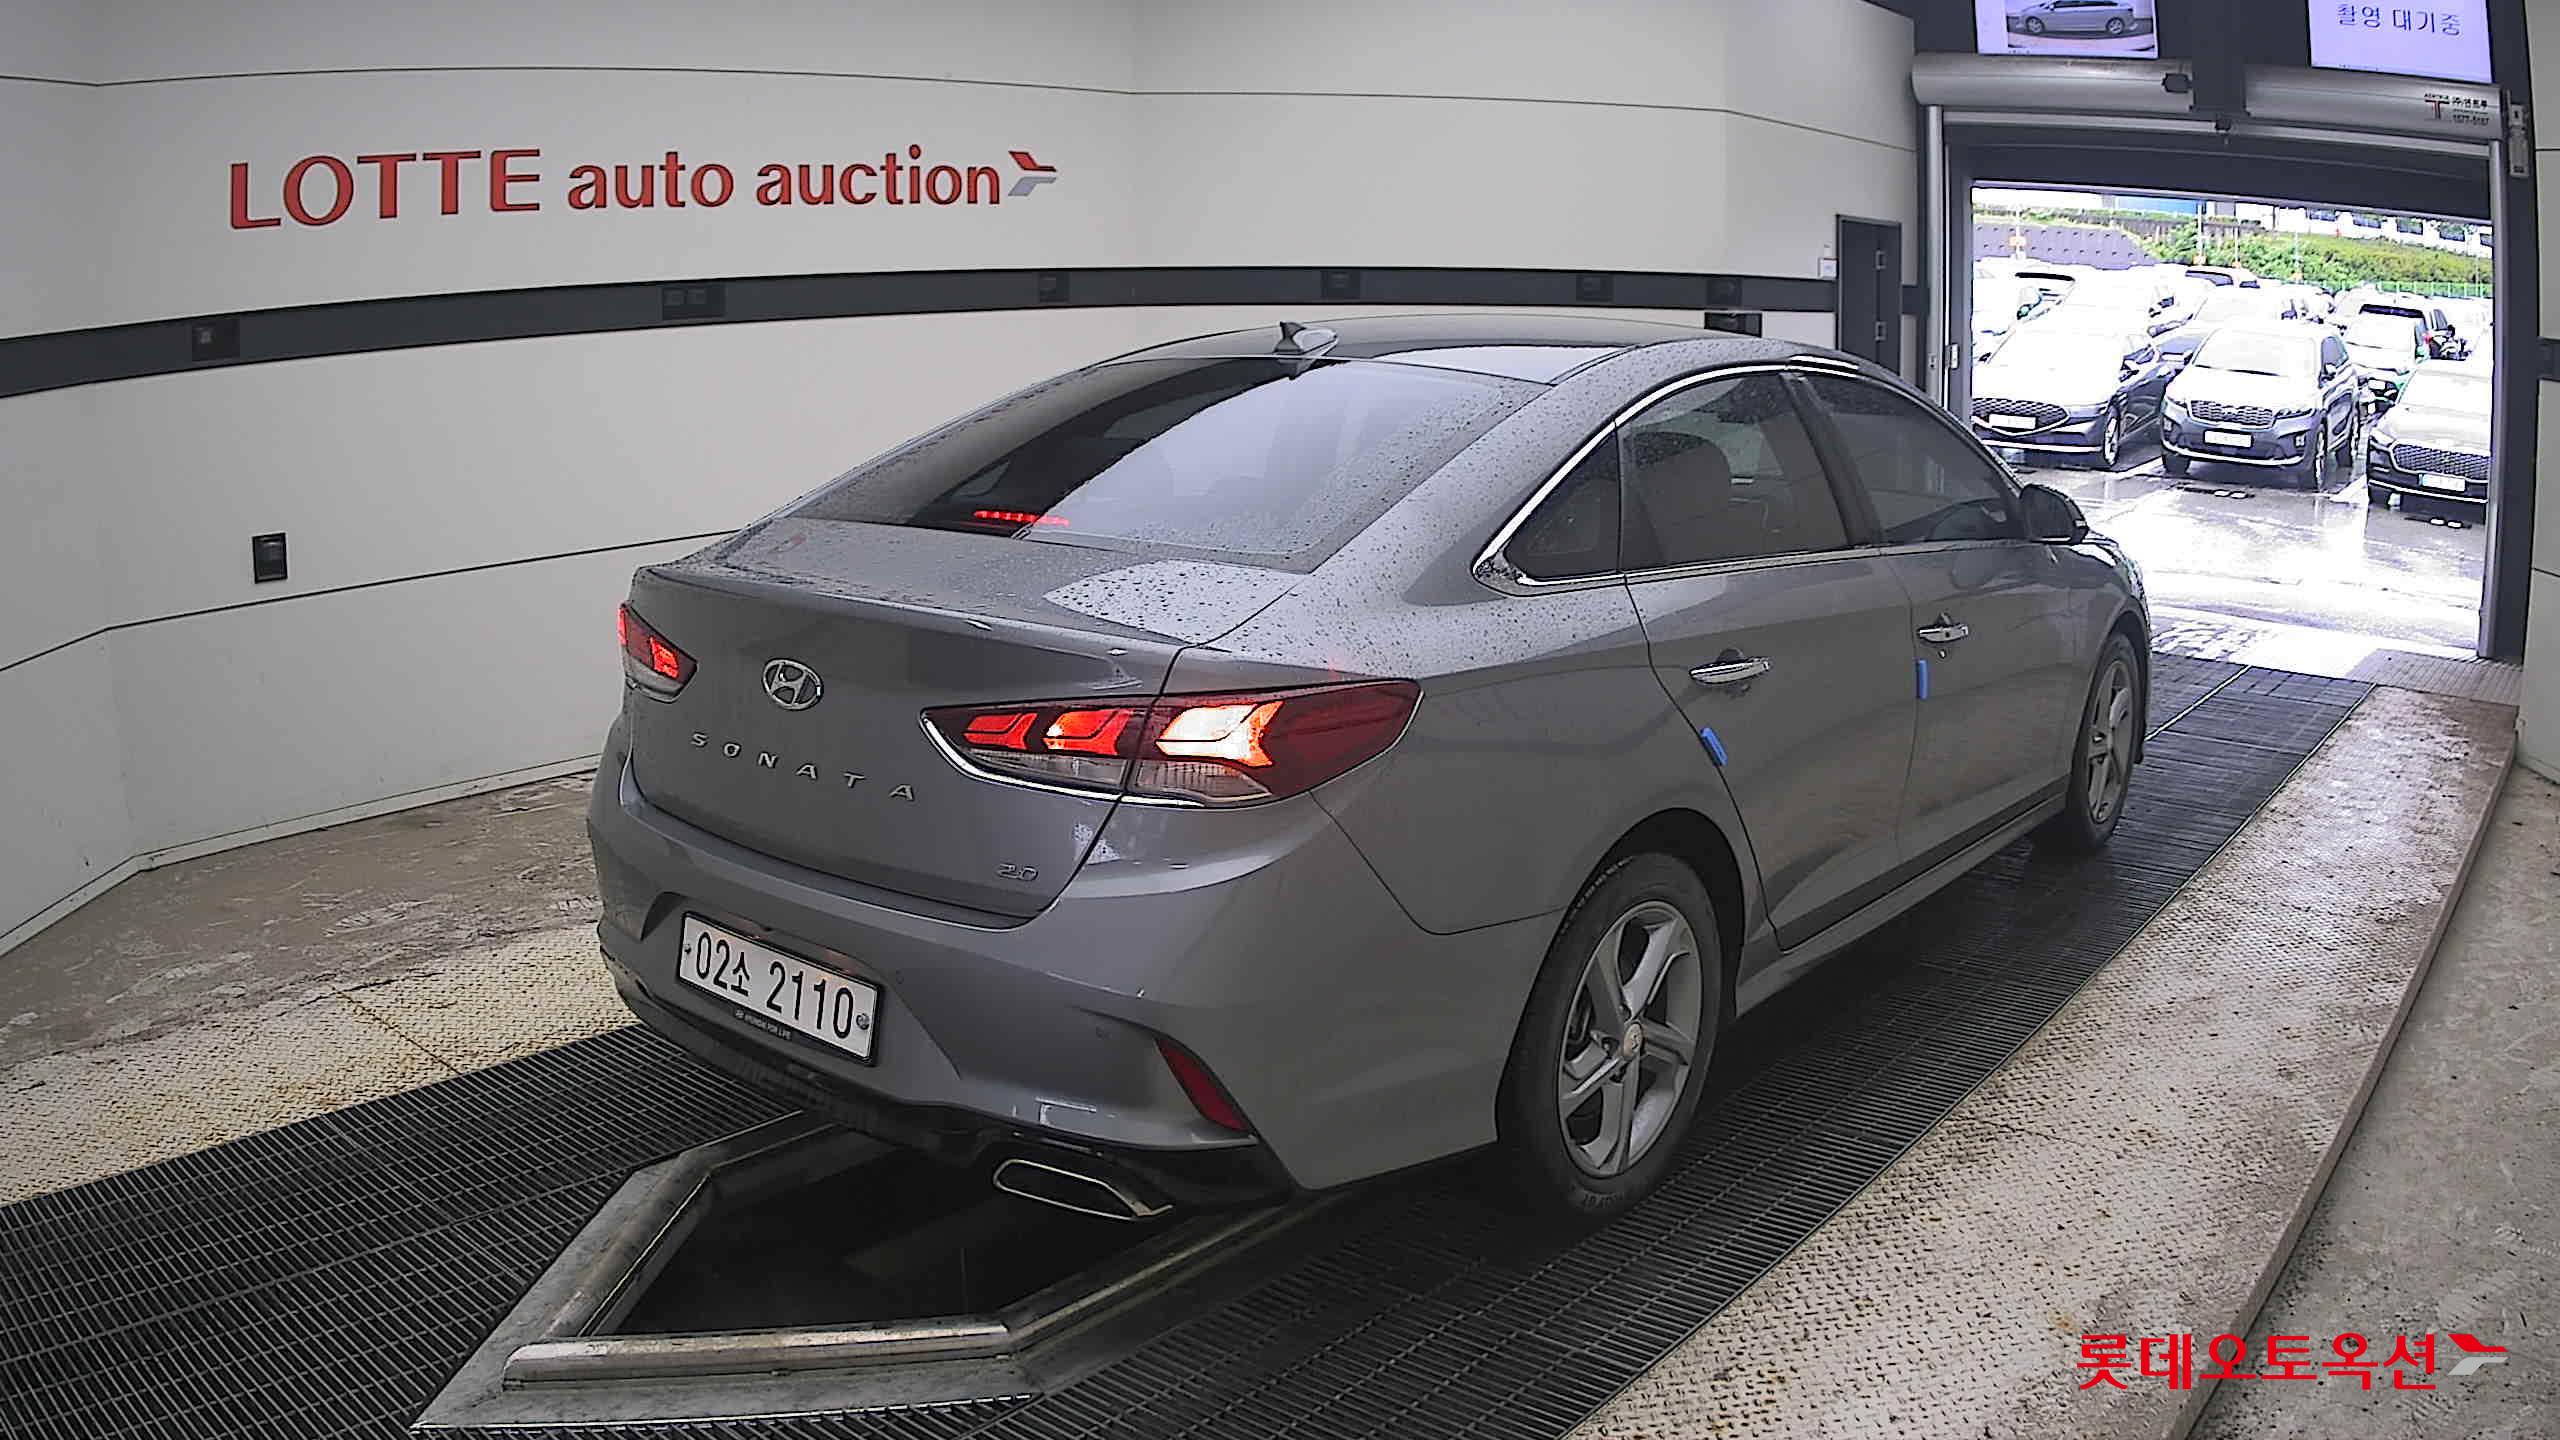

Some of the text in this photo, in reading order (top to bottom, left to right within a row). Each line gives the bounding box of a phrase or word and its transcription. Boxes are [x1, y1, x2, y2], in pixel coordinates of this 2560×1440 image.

[2337, 3, 2381, 28] 촬영
[230, 143, 1001, 230] LOTTE auto auction
[690, 732, 915, 801] SONATA
[696, 931, 750, 997] 02소
[766, 960, 854, 1039] 2110
